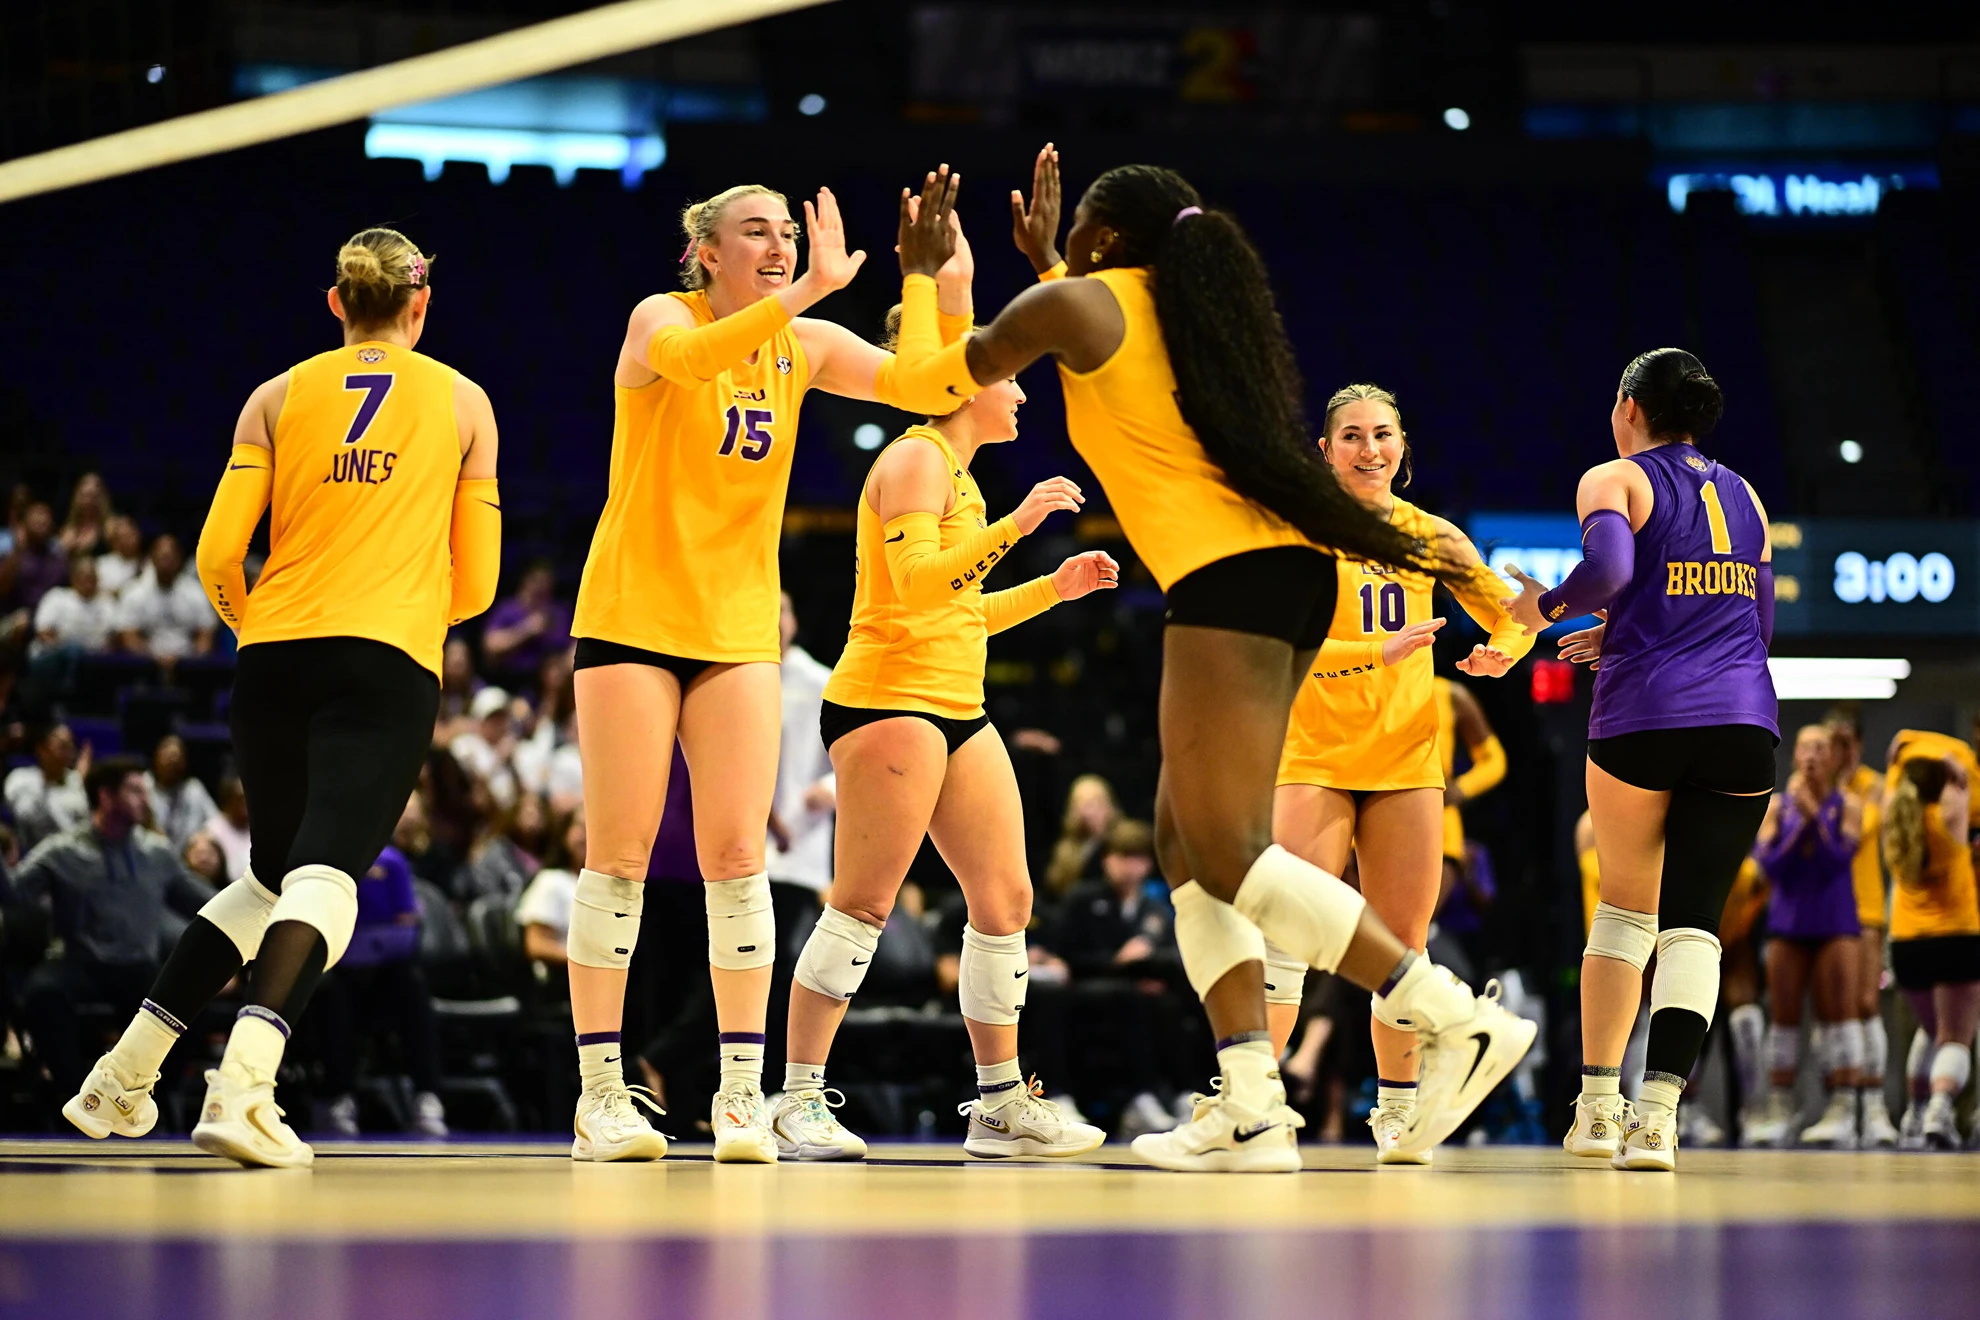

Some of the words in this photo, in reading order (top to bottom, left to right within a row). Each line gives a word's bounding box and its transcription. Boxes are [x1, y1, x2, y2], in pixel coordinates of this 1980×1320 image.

[342, 372, 396, 446] 7
[717, 405, 775, 463] 15
[323, 447, 398, 485] ONES
[1699, 479, 1733, 554] 1
[950, 540, 1010, 591] GEAUX
[1361, 563, 1398, 575] LSU
[1666, 561, 1757, 601] BROOKS
[1833, 551, 1955, 604] 3:00
[1358, 582, 1407, 634] 10
[1313, 662, 1375, 679] GEAUX
[155, 1009, 179, 1028] GRIP
[115, 1095, 130, 1110] LSU
[979, 1115, 1001, 1127] LSU
[1612, 1112, 1621, 1123] LS
[1628, 1121, 1640, 1132] LSU
